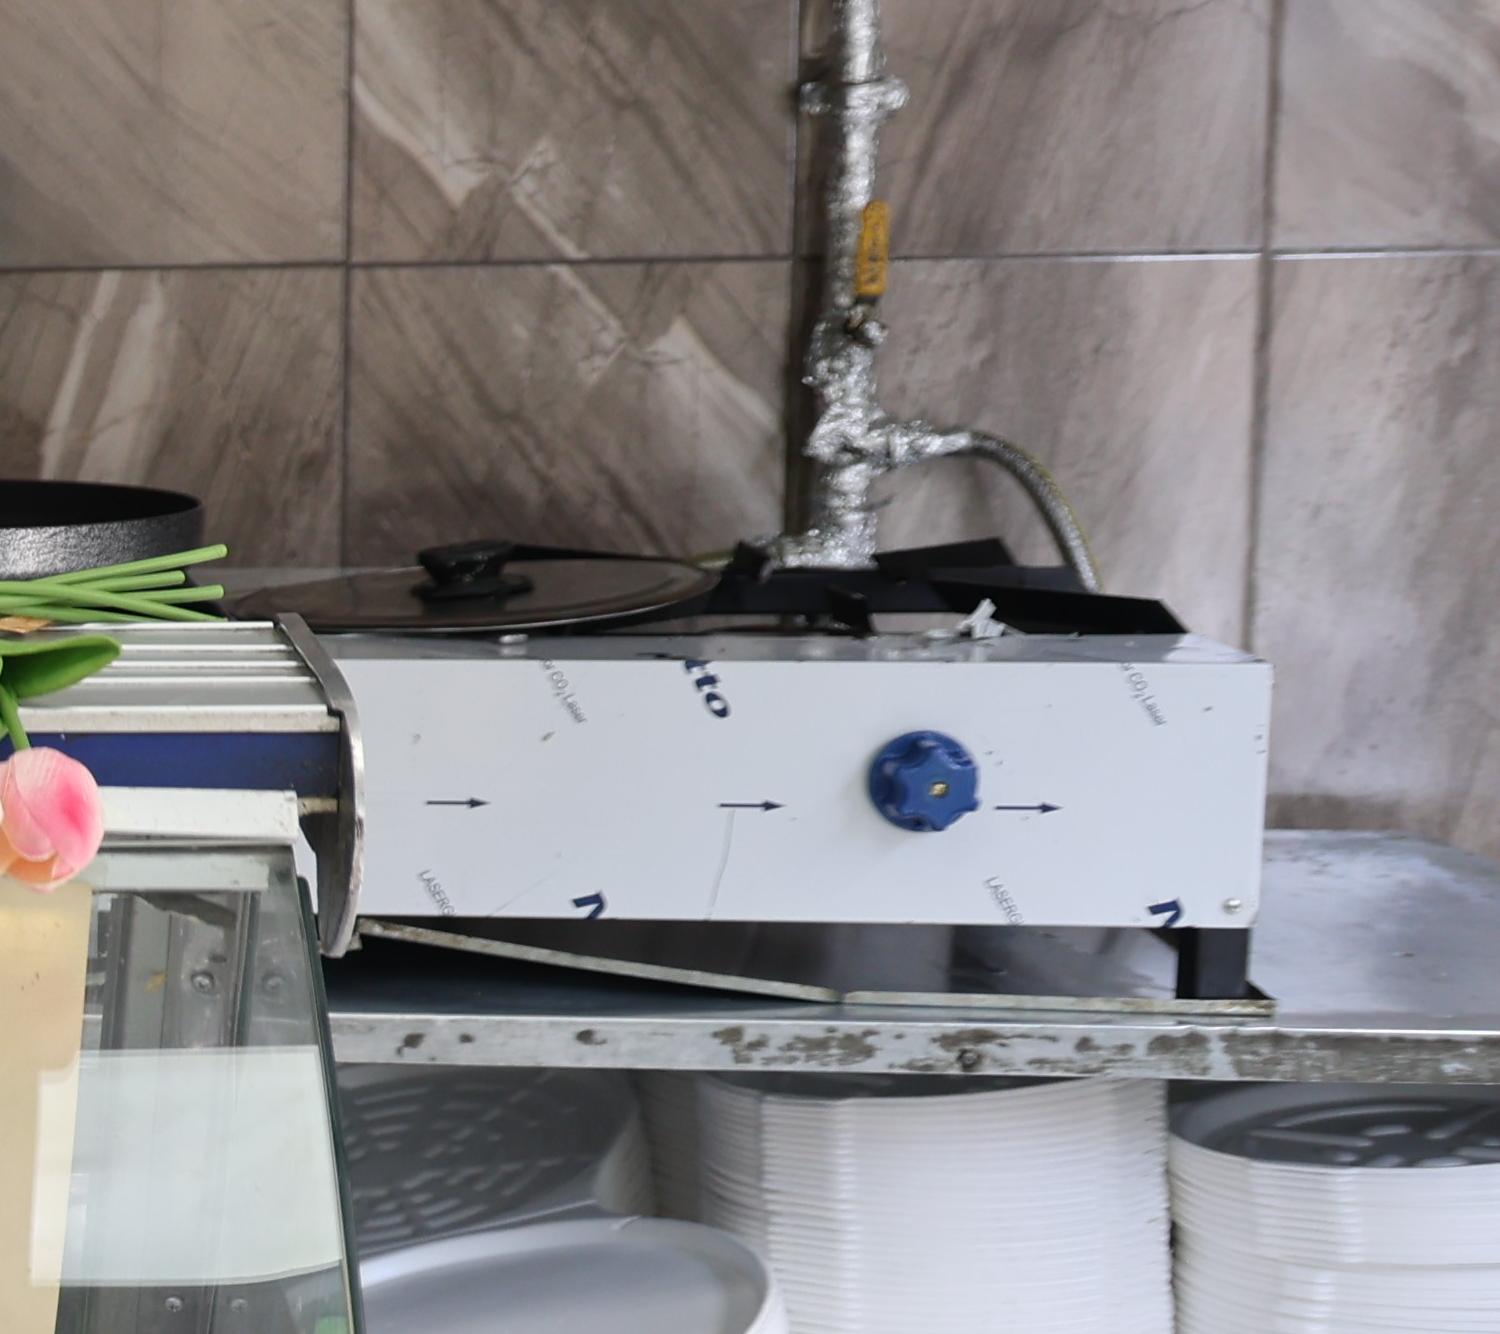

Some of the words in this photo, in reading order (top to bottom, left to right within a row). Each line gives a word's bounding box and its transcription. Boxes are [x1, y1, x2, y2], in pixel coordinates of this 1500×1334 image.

[683, 659, 731, 718] tto
[417, 869, 456, 917] LASERG
[983, 876, 1025, 925] LASERG
